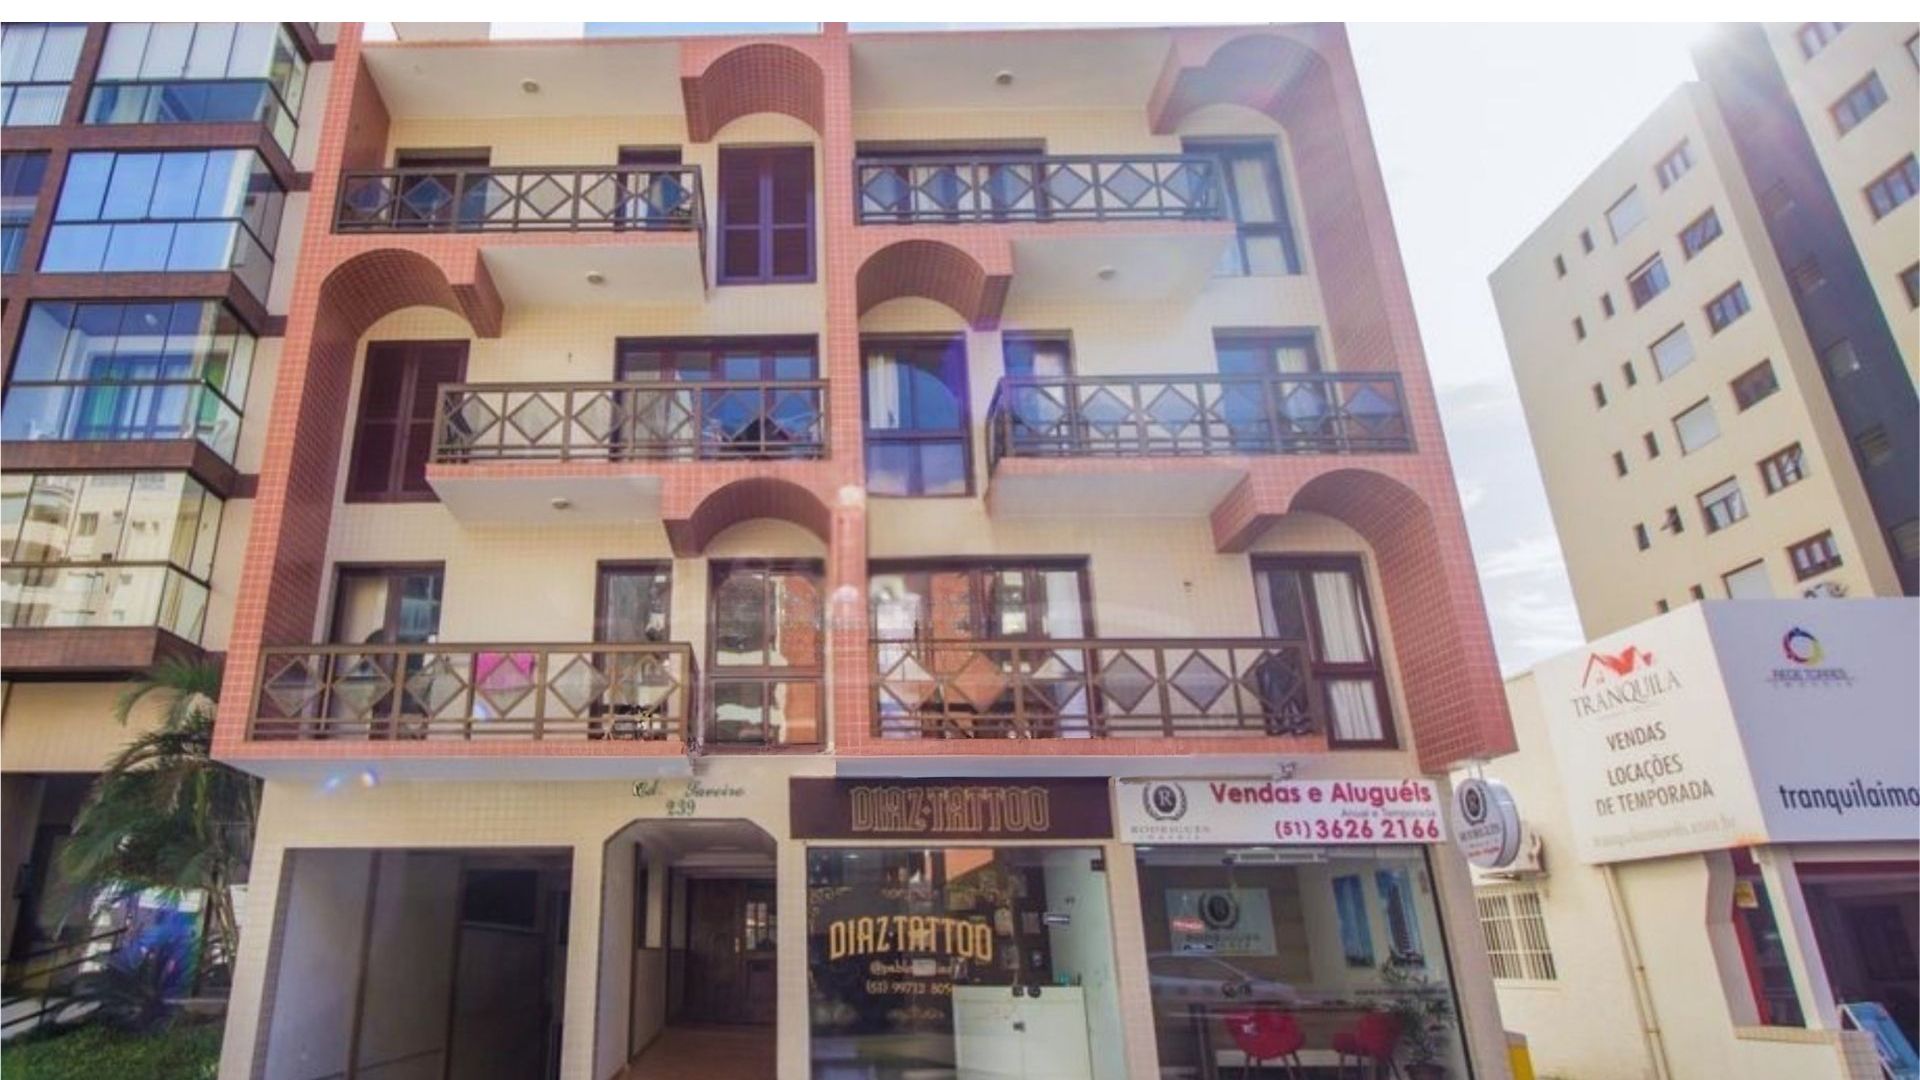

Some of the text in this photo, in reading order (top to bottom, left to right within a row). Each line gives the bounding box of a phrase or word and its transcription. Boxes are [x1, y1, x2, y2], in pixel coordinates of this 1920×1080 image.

[1571, 669, 1682, 718] TRANQUILA
[1606, 721, 1667, 751] VENDAS
[1607, 753, 1683, 786] LOCAÇÕES
[1210, 782, 1301, 803] Vendas
[1308, 787, 1322, 802] e
[1596, 779, 1714, 816] DE TEMPORADA
[1779, 778, 1919, 814] tranquilaimo
[1275, 821, 1311, 839] (51)
[1316, 819, 1373, 839] 3626
[1380, 819, 1440, 839] 2166
